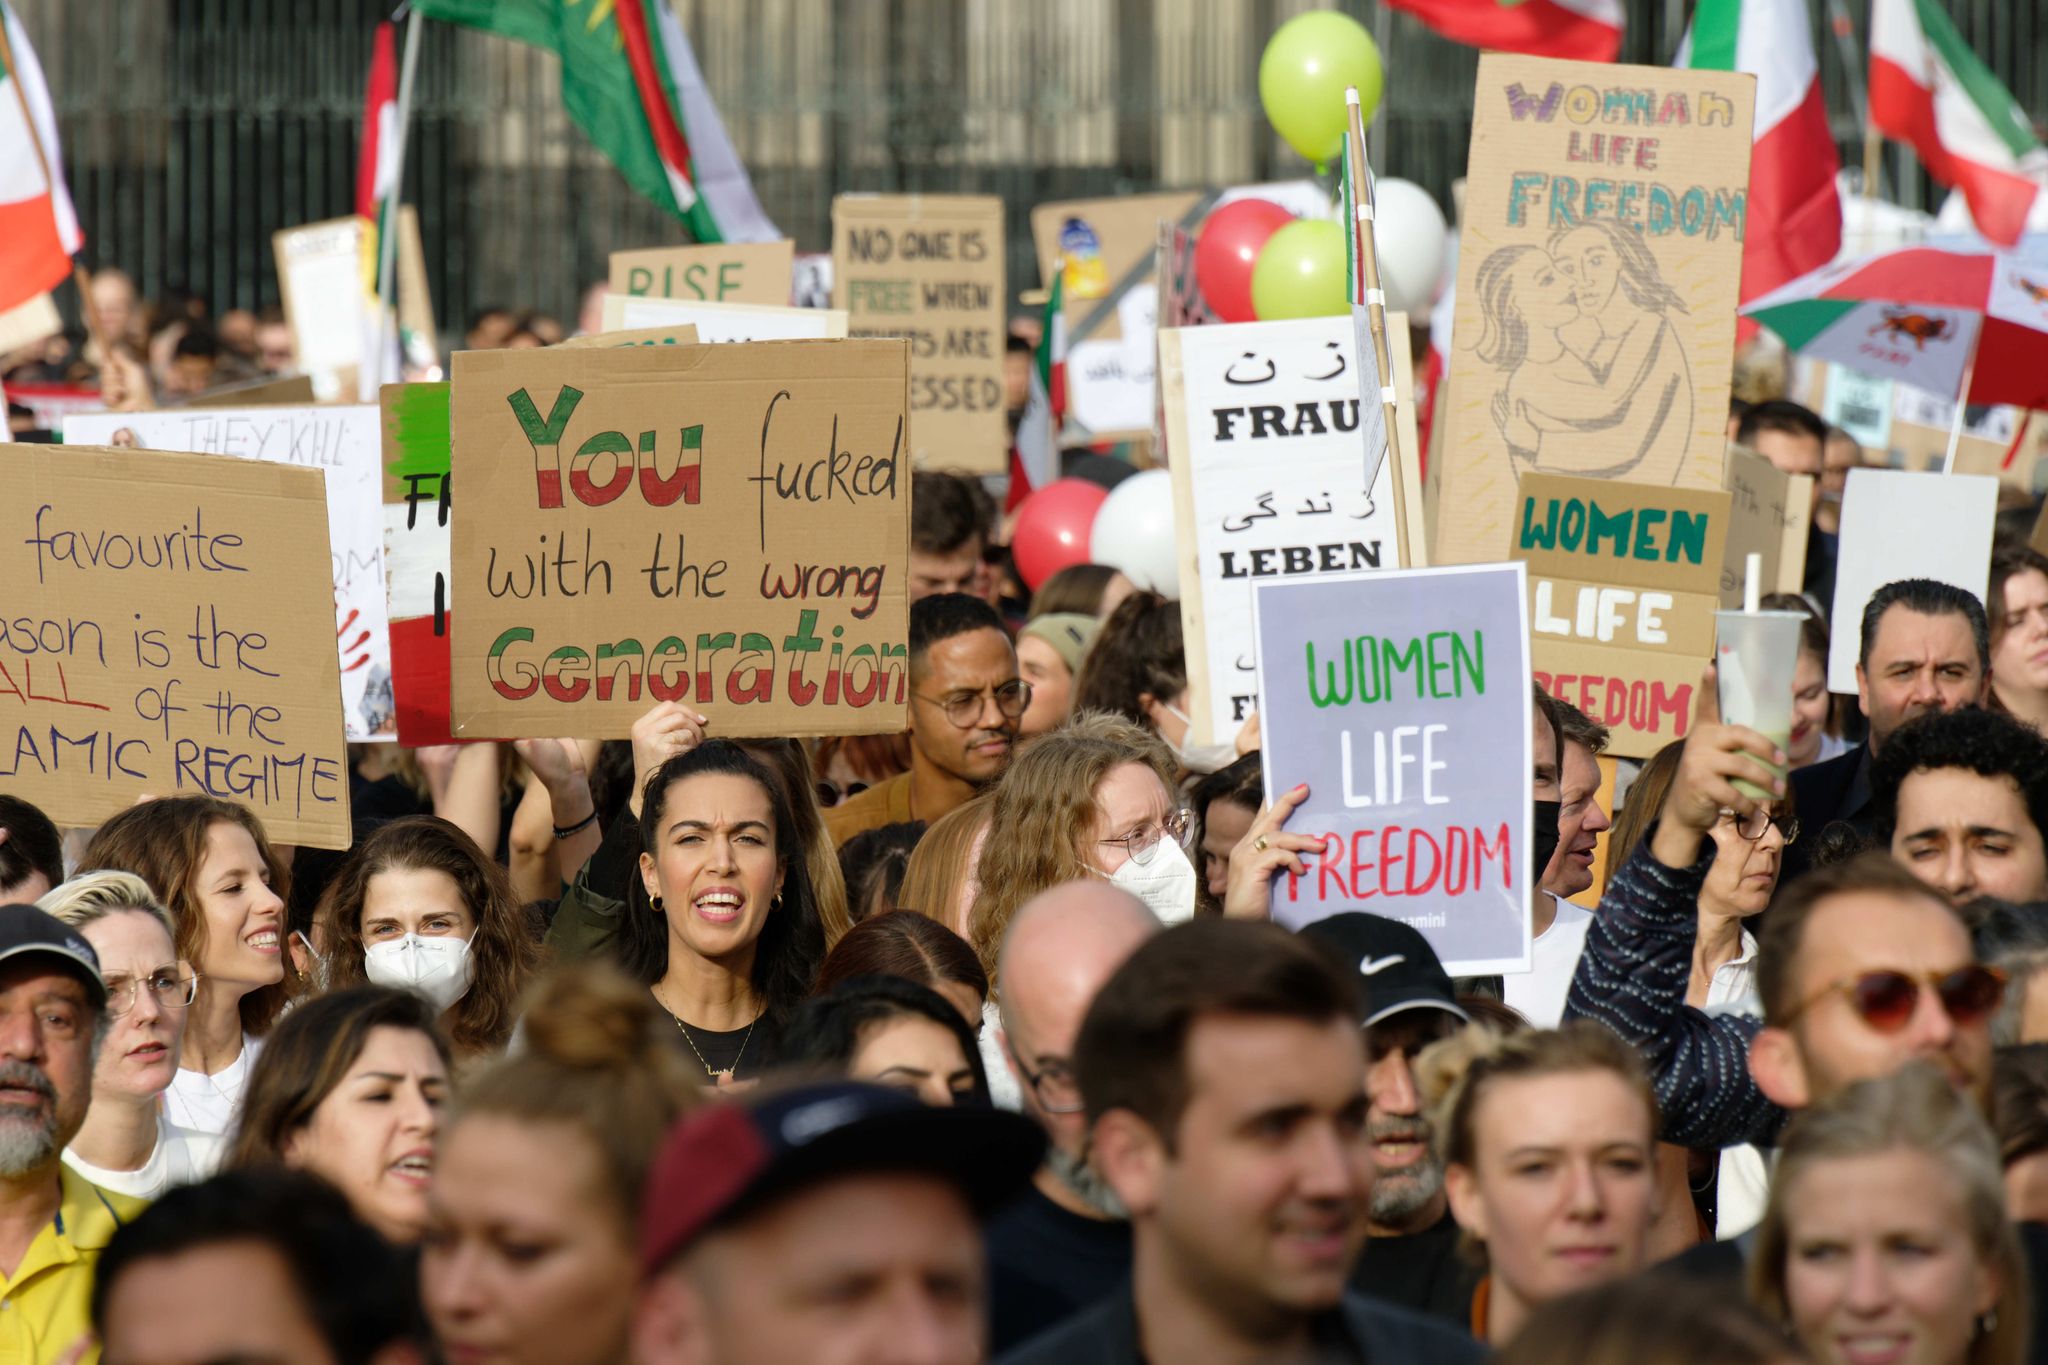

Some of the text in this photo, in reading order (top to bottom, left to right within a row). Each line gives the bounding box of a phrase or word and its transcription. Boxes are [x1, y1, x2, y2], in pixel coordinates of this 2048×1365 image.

[1567, 131, 1660, 171] LIFE
[1506, 171, 1748, 242] FREEDOM
[848, 227, 987, 264] NO ONE IS
[849, 279, 993, 314] FREE WHEN
[945, 327, 993, 359] ARE
[183, 417, 345, 466] THEY KILL
[1212, 399, 1360, 442] FRAU
[507, 385, 903, 554] You fucked
[25, 504, 249, 584] favourite
[1220, 540, 1382, 579] LEBEN
[1519, 496, 1709, 565] WOMEN
[486, 528, 886, 620] with the wrong
[134, 613, 171, 668] is
[187, 604, 280, 677] the
[1534, 580, 1673, 644] LIFE
[486, 608, 907, 707] Generation
[1306, 630, 1485, 708] WOMEN
[135, 679, 187, 741] of
[202, 690, 285, 745] the
[1231, 693, 1257, 721] F
[175, 738, 340, 818] REGIME
[1341, 724, 1450, 808] LIFE
